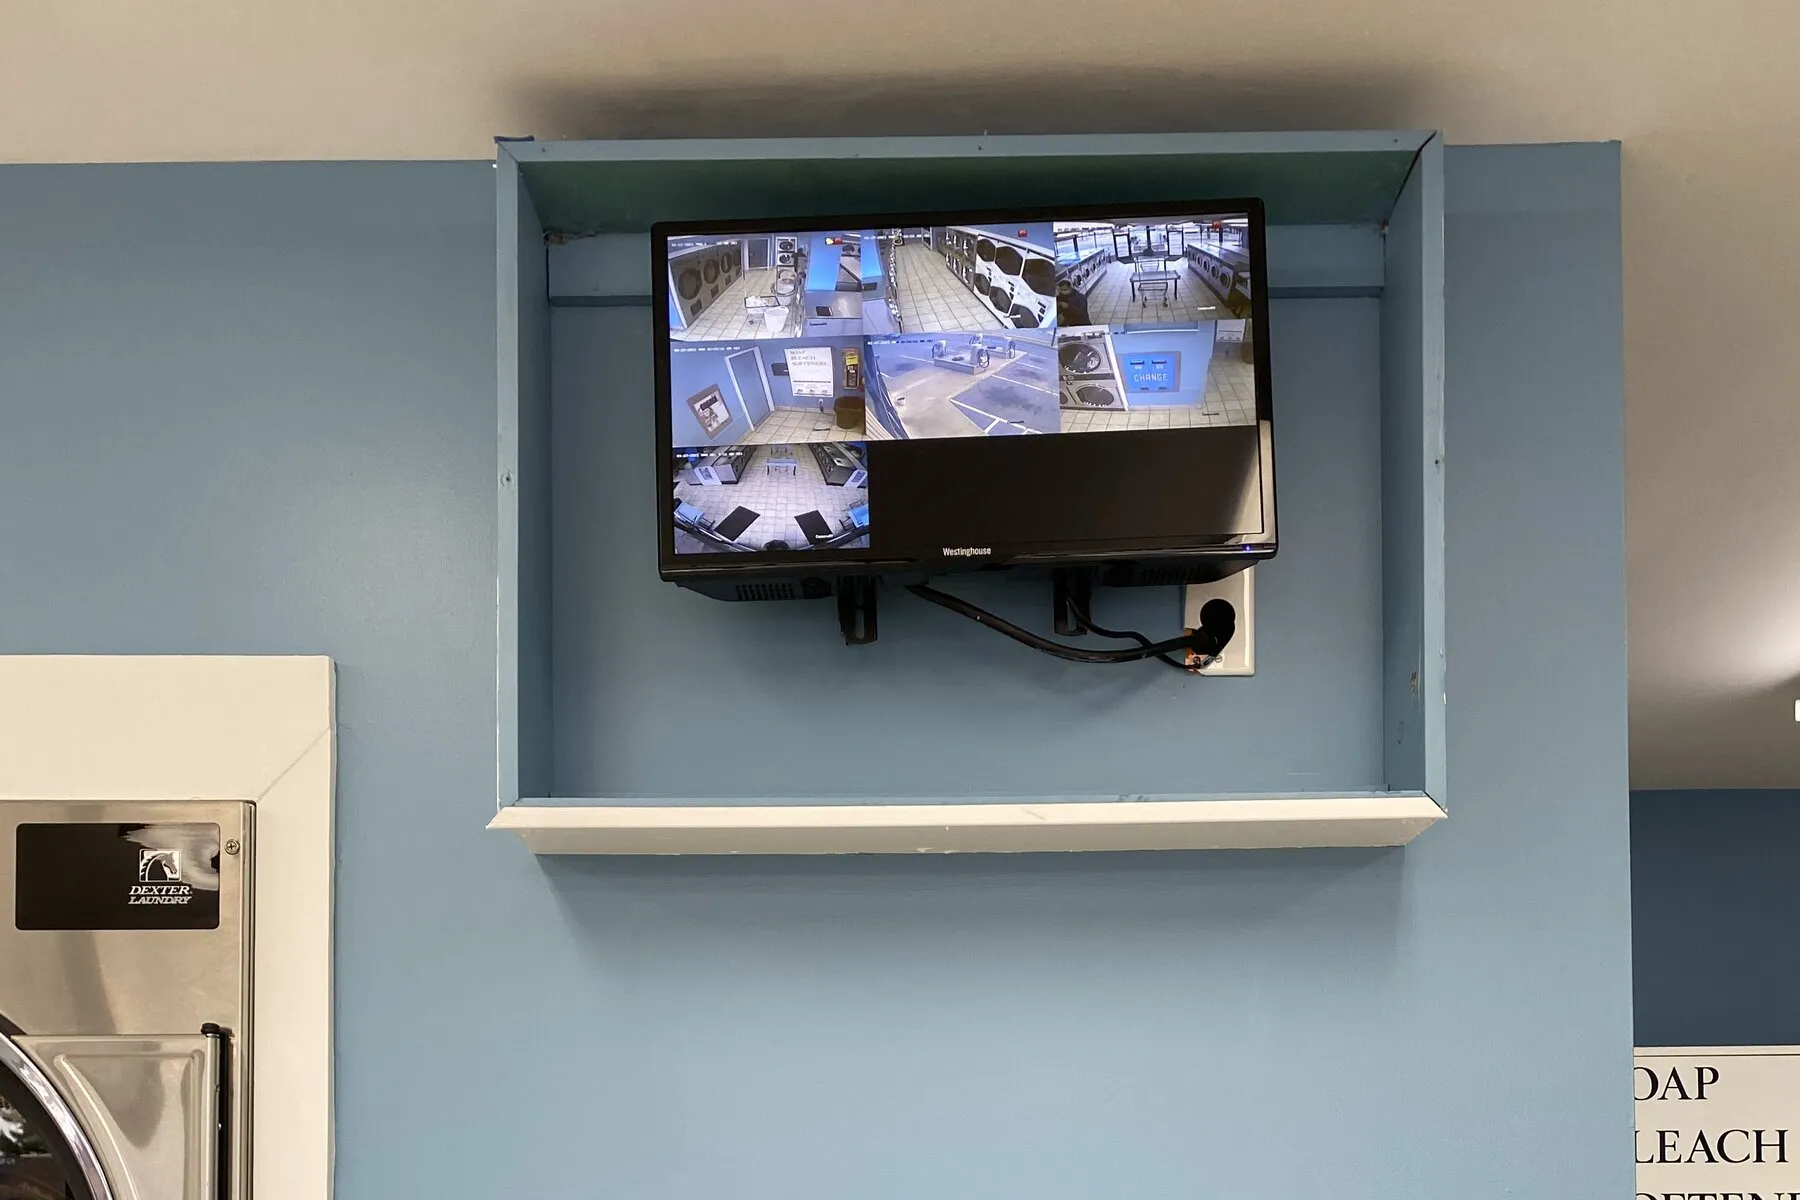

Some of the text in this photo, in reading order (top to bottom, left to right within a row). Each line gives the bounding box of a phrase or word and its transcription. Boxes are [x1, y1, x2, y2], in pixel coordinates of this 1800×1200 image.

[1133, 373, 1169, 382] CHANGE
[942, 547, 992, 557] Westinghouse
[128, 885, 190, 895] DEXTER
[128, 896, 192, 905] LAUNDRY
